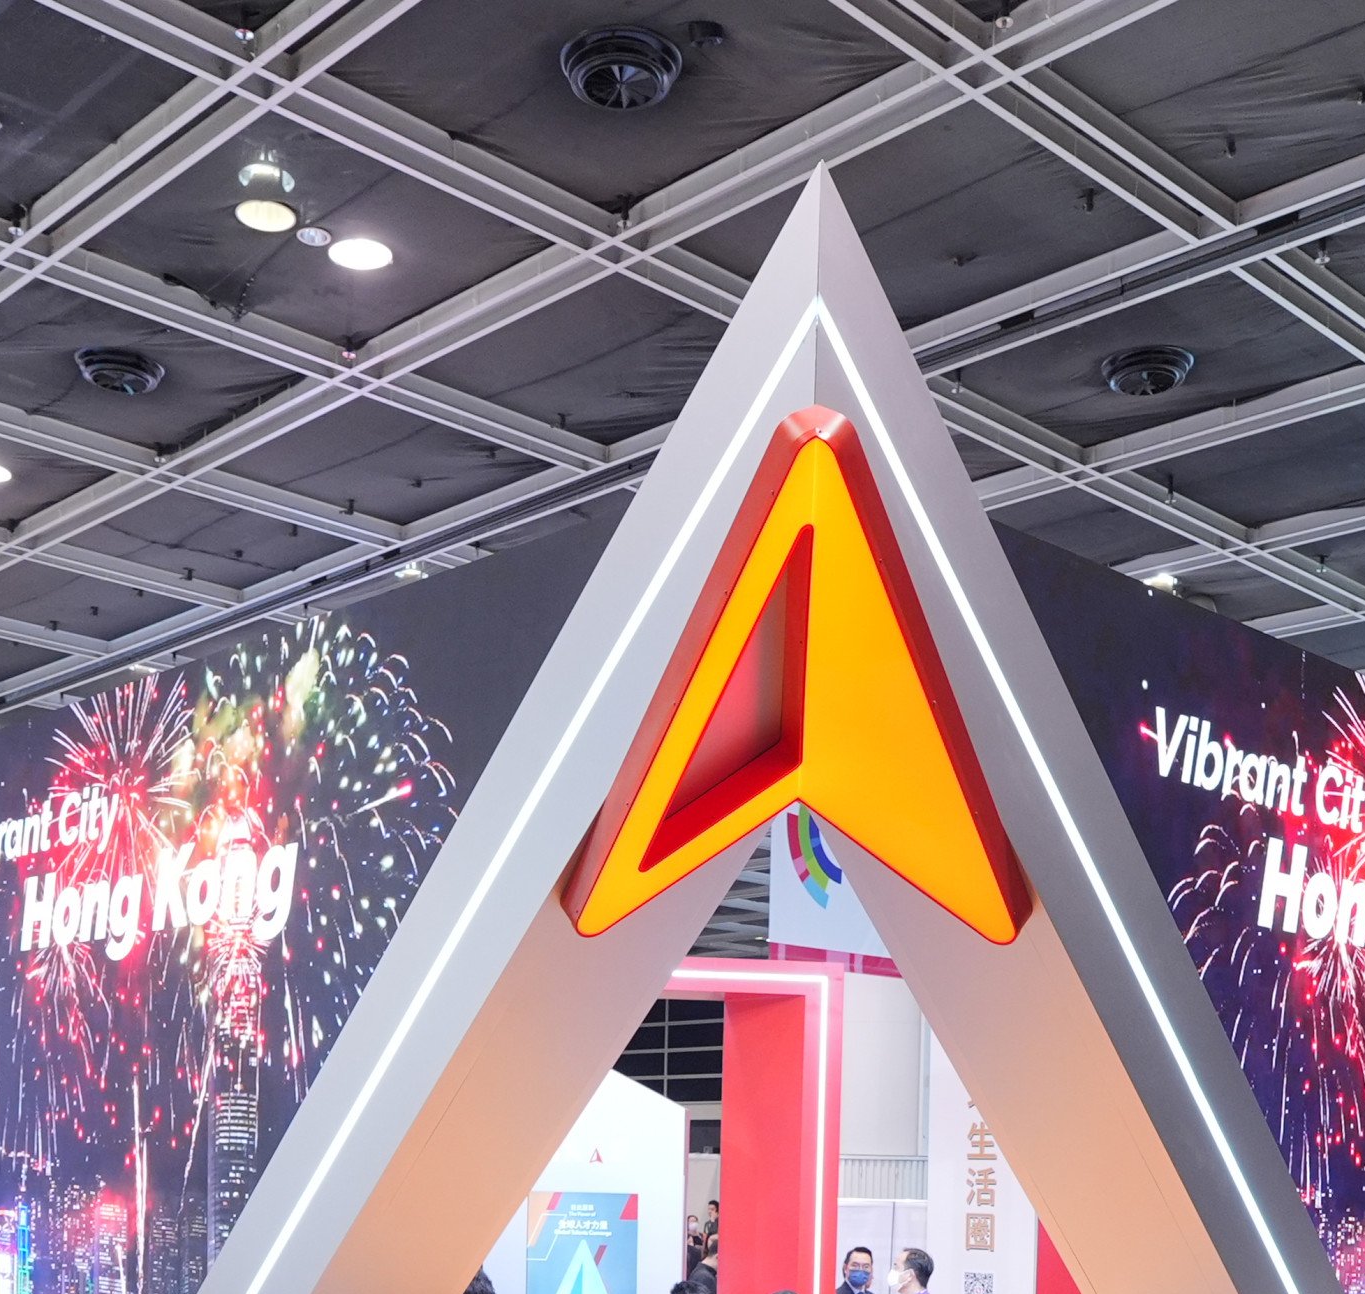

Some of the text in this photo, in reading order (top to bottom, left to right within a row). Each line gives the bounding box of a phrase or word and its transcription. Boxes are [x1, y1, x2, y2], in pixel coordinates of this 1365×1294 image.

[1155, 706, 1308, 817] Vibrant
[59, 787, 120, 854] City
[20, 842, 298, 961] Hong Kong
[965, 1100, 998, 1253] 生活圈
